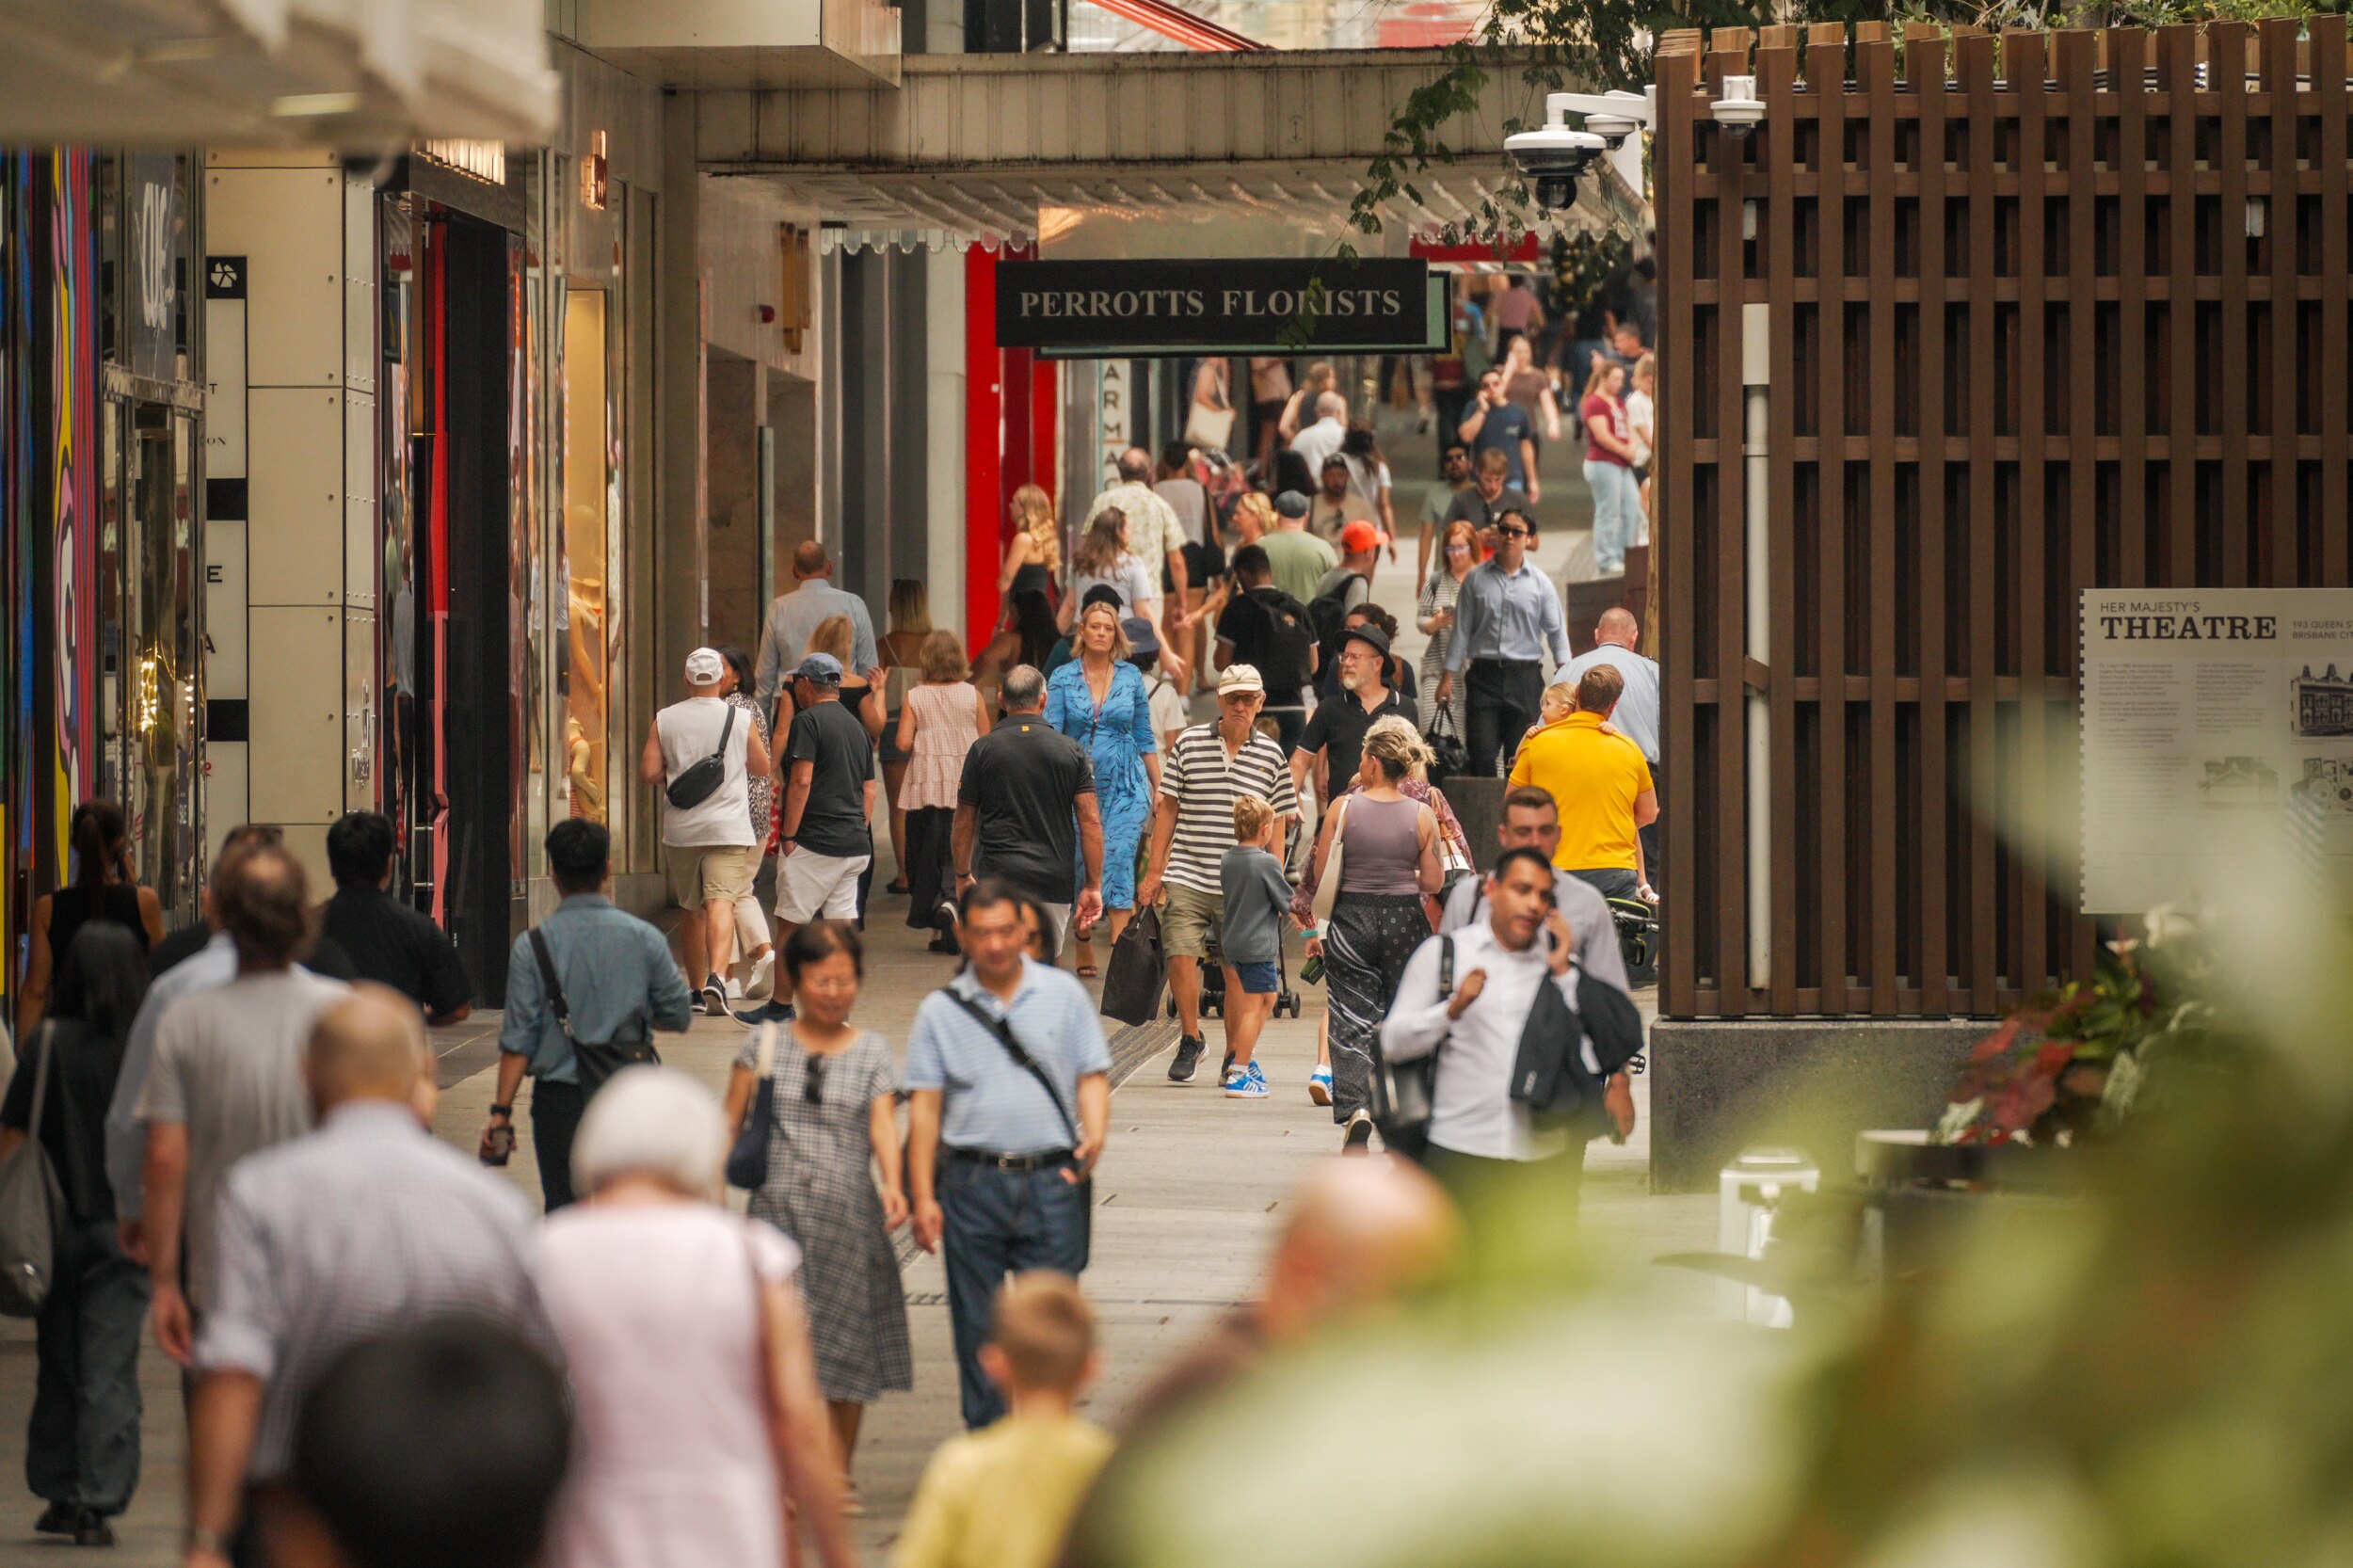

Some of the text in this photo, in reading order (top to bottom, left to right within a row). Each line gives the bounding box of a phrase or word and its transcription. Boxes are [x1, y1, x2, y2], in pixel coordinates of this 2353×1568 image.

[1019, 289, 1401, 317] PERROTTS FLORISTS
[2100, 601, 2201, 613] HER MAJESTY'S
[2100, 616, 2277, 640] THEATRE
[2292, 620, 2309, 630] 193
[2310, 620, 2344, 630] QUEEN
[2292, 631, 2336, 640] BRISBANE
